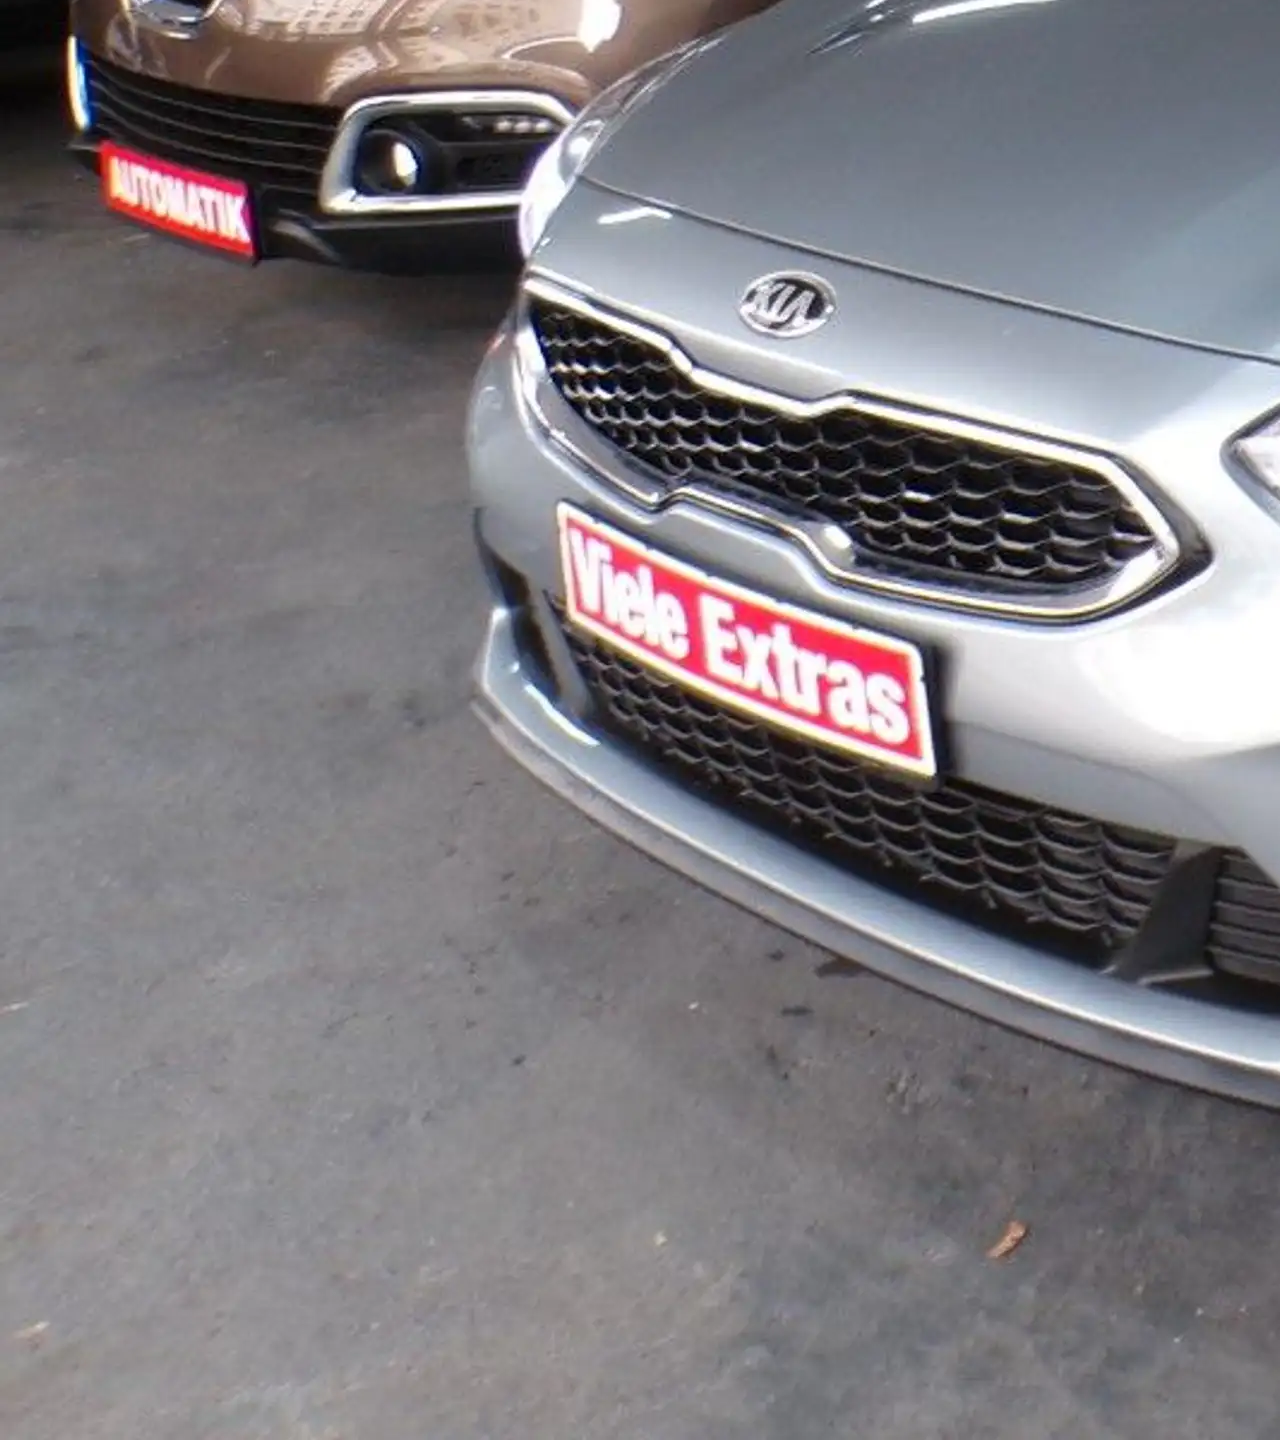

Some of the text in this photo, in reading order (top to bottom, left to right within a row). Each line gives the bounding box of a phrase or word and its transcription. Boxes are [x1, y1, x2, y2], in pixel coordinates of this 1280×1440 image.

[109, 155, 251, 244] AUTOMATIK
[744, 281, 817, 328] KIA
[569, 526, 910, 744] Viele Extras
